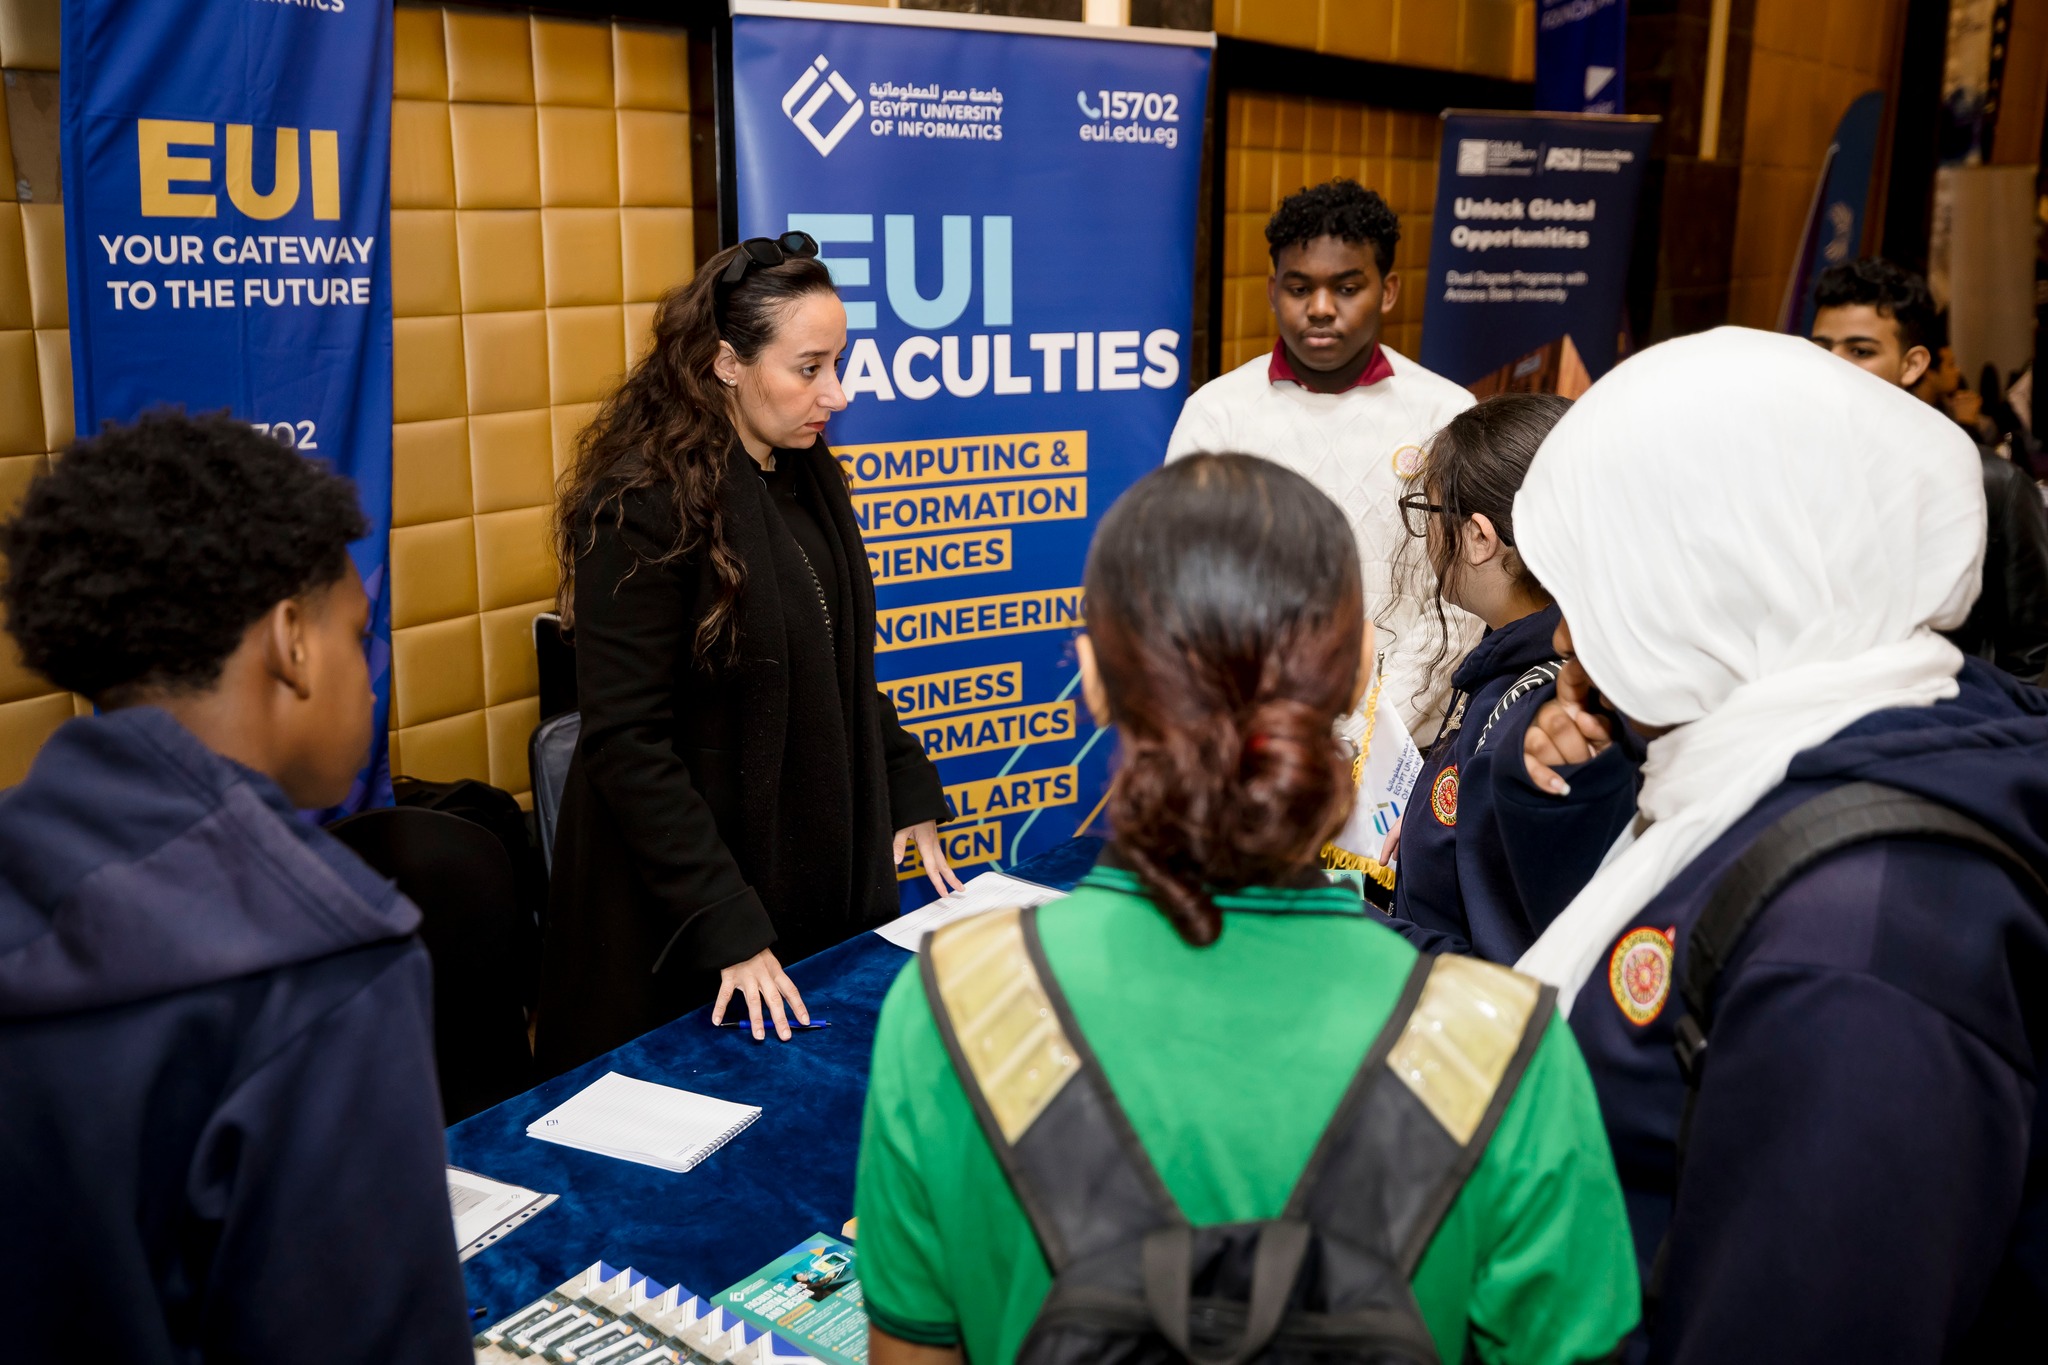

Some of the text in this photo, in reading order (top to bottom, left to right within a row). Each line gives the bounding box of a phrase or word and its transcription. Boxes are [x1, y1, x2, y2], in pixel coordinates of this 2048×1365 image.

[869, 81, 1003, 105] جامعة مصر للمعلوماتية
[1099, 90, 1179, 122] 15702
[870, 101, 1003, 122] EGYPT UNIVERSITY
[870, 119, 1003, 141] OF INFORMATICS
[1079, 120, 1178, 149] eui.edu.eg
[138, 118, 340, 221] EUI
[1454, 197, 1596, 221] Unlock Global
[99, 235, 374, 265] YOUR GATEWAY
[1450, 225, 1590, 252] Opportunities
[787, 213, 1013, 331] EUI
[107, 277, 370, 310] TO THE FUTURE
[840, 328, 1180, 402] ACULTIES
[1050, 440, 1070, 467] &
[851, 485, 1077, 531] NFORMATION
[866, 538, 1005, 580] IENCES
[875, 595, 1089, 646] NGINEEERIN
[887, 670, 1015, 714] SINESS
[909, 708, 1070, 755] RMATICS
[985, 773, 1072, 812] ARTS
[1393, 772, 1407, 796] EGYPT
[1401, 788, 1409, 800] OF
